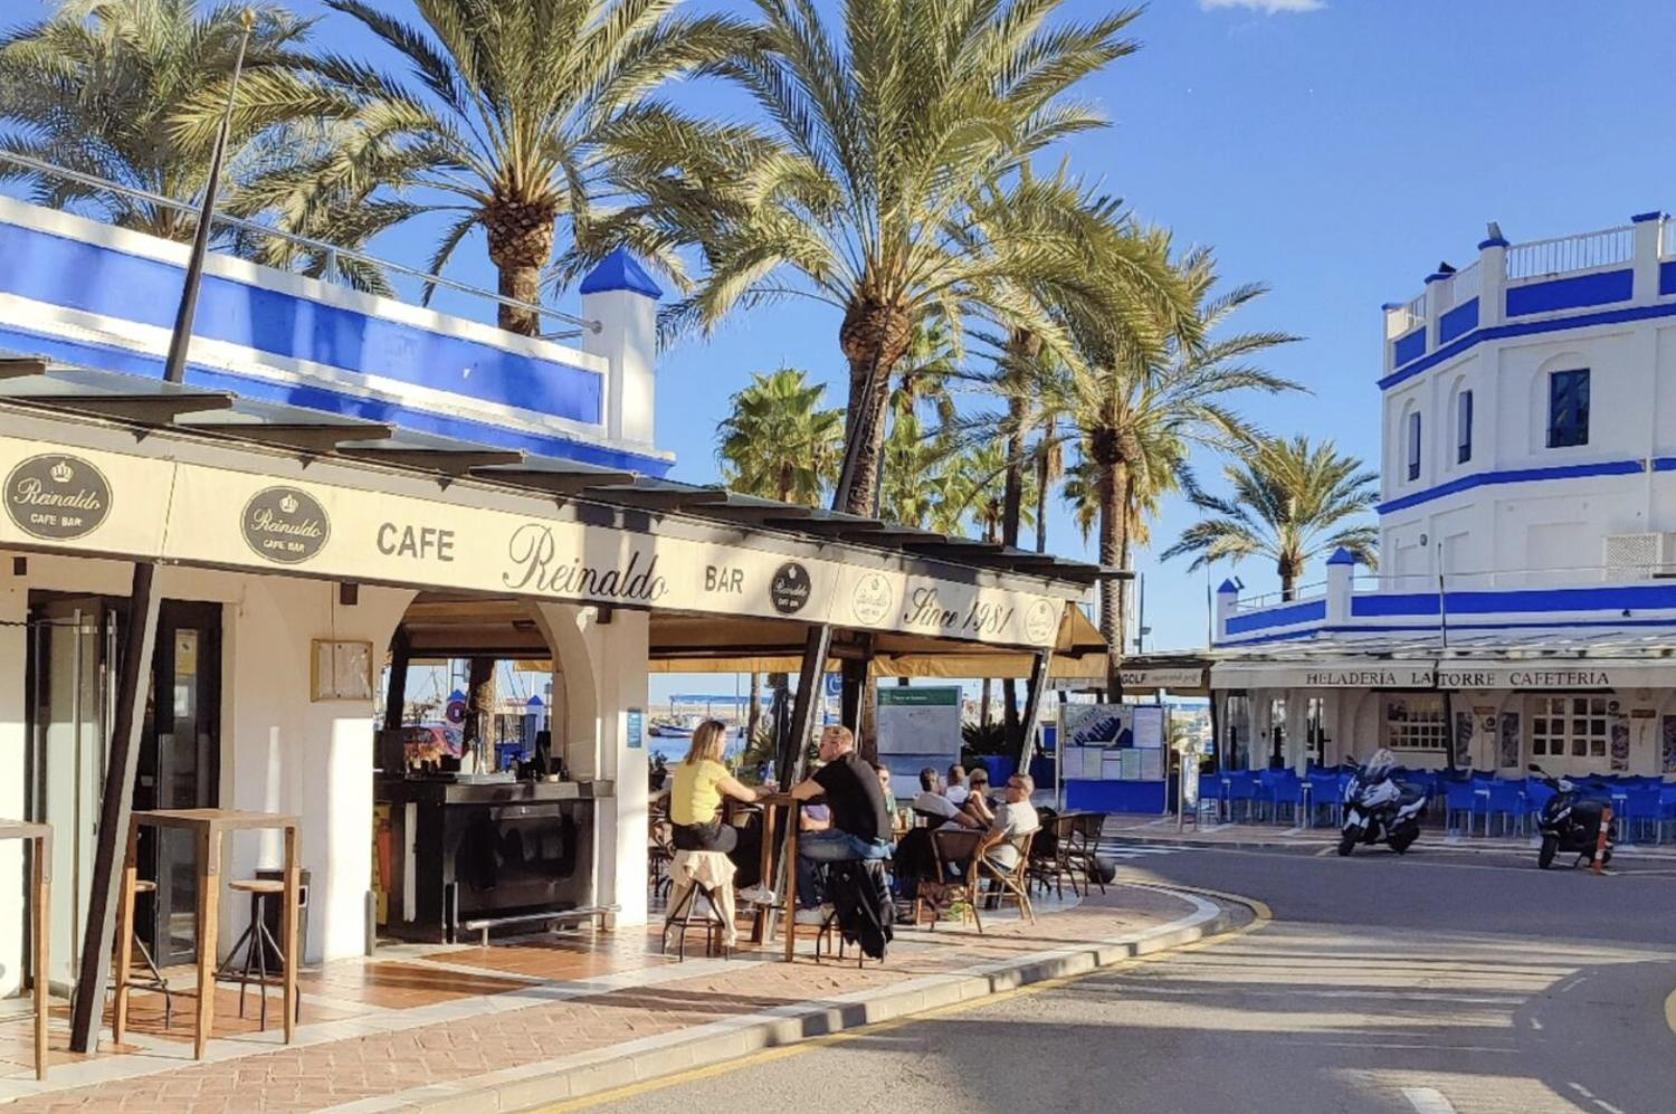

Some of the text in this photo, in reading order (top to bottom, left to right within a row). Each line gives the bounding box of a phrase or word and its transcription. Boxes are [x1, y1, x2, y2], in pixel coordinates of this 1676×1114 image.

[13, 477, 101, 510] Reinaldo
[30, 513, 83, 527] CAFE BAR
[250, 507, 322, 538] Reinaldo
[263, 539, 305, 553] CAFE BAR
[376, 521, 744, 602] CAFE Reinaldo BAR
[773, 577, 808, 597] Raldo
[903, 587, 959, 629] Since
[962, 601, 1015, 634] 1981
[1121, 673, 1147, 685] GOLF
[1411, 672, 1431, 685] LA
[1439, 673, 1495, 686] TORRE
